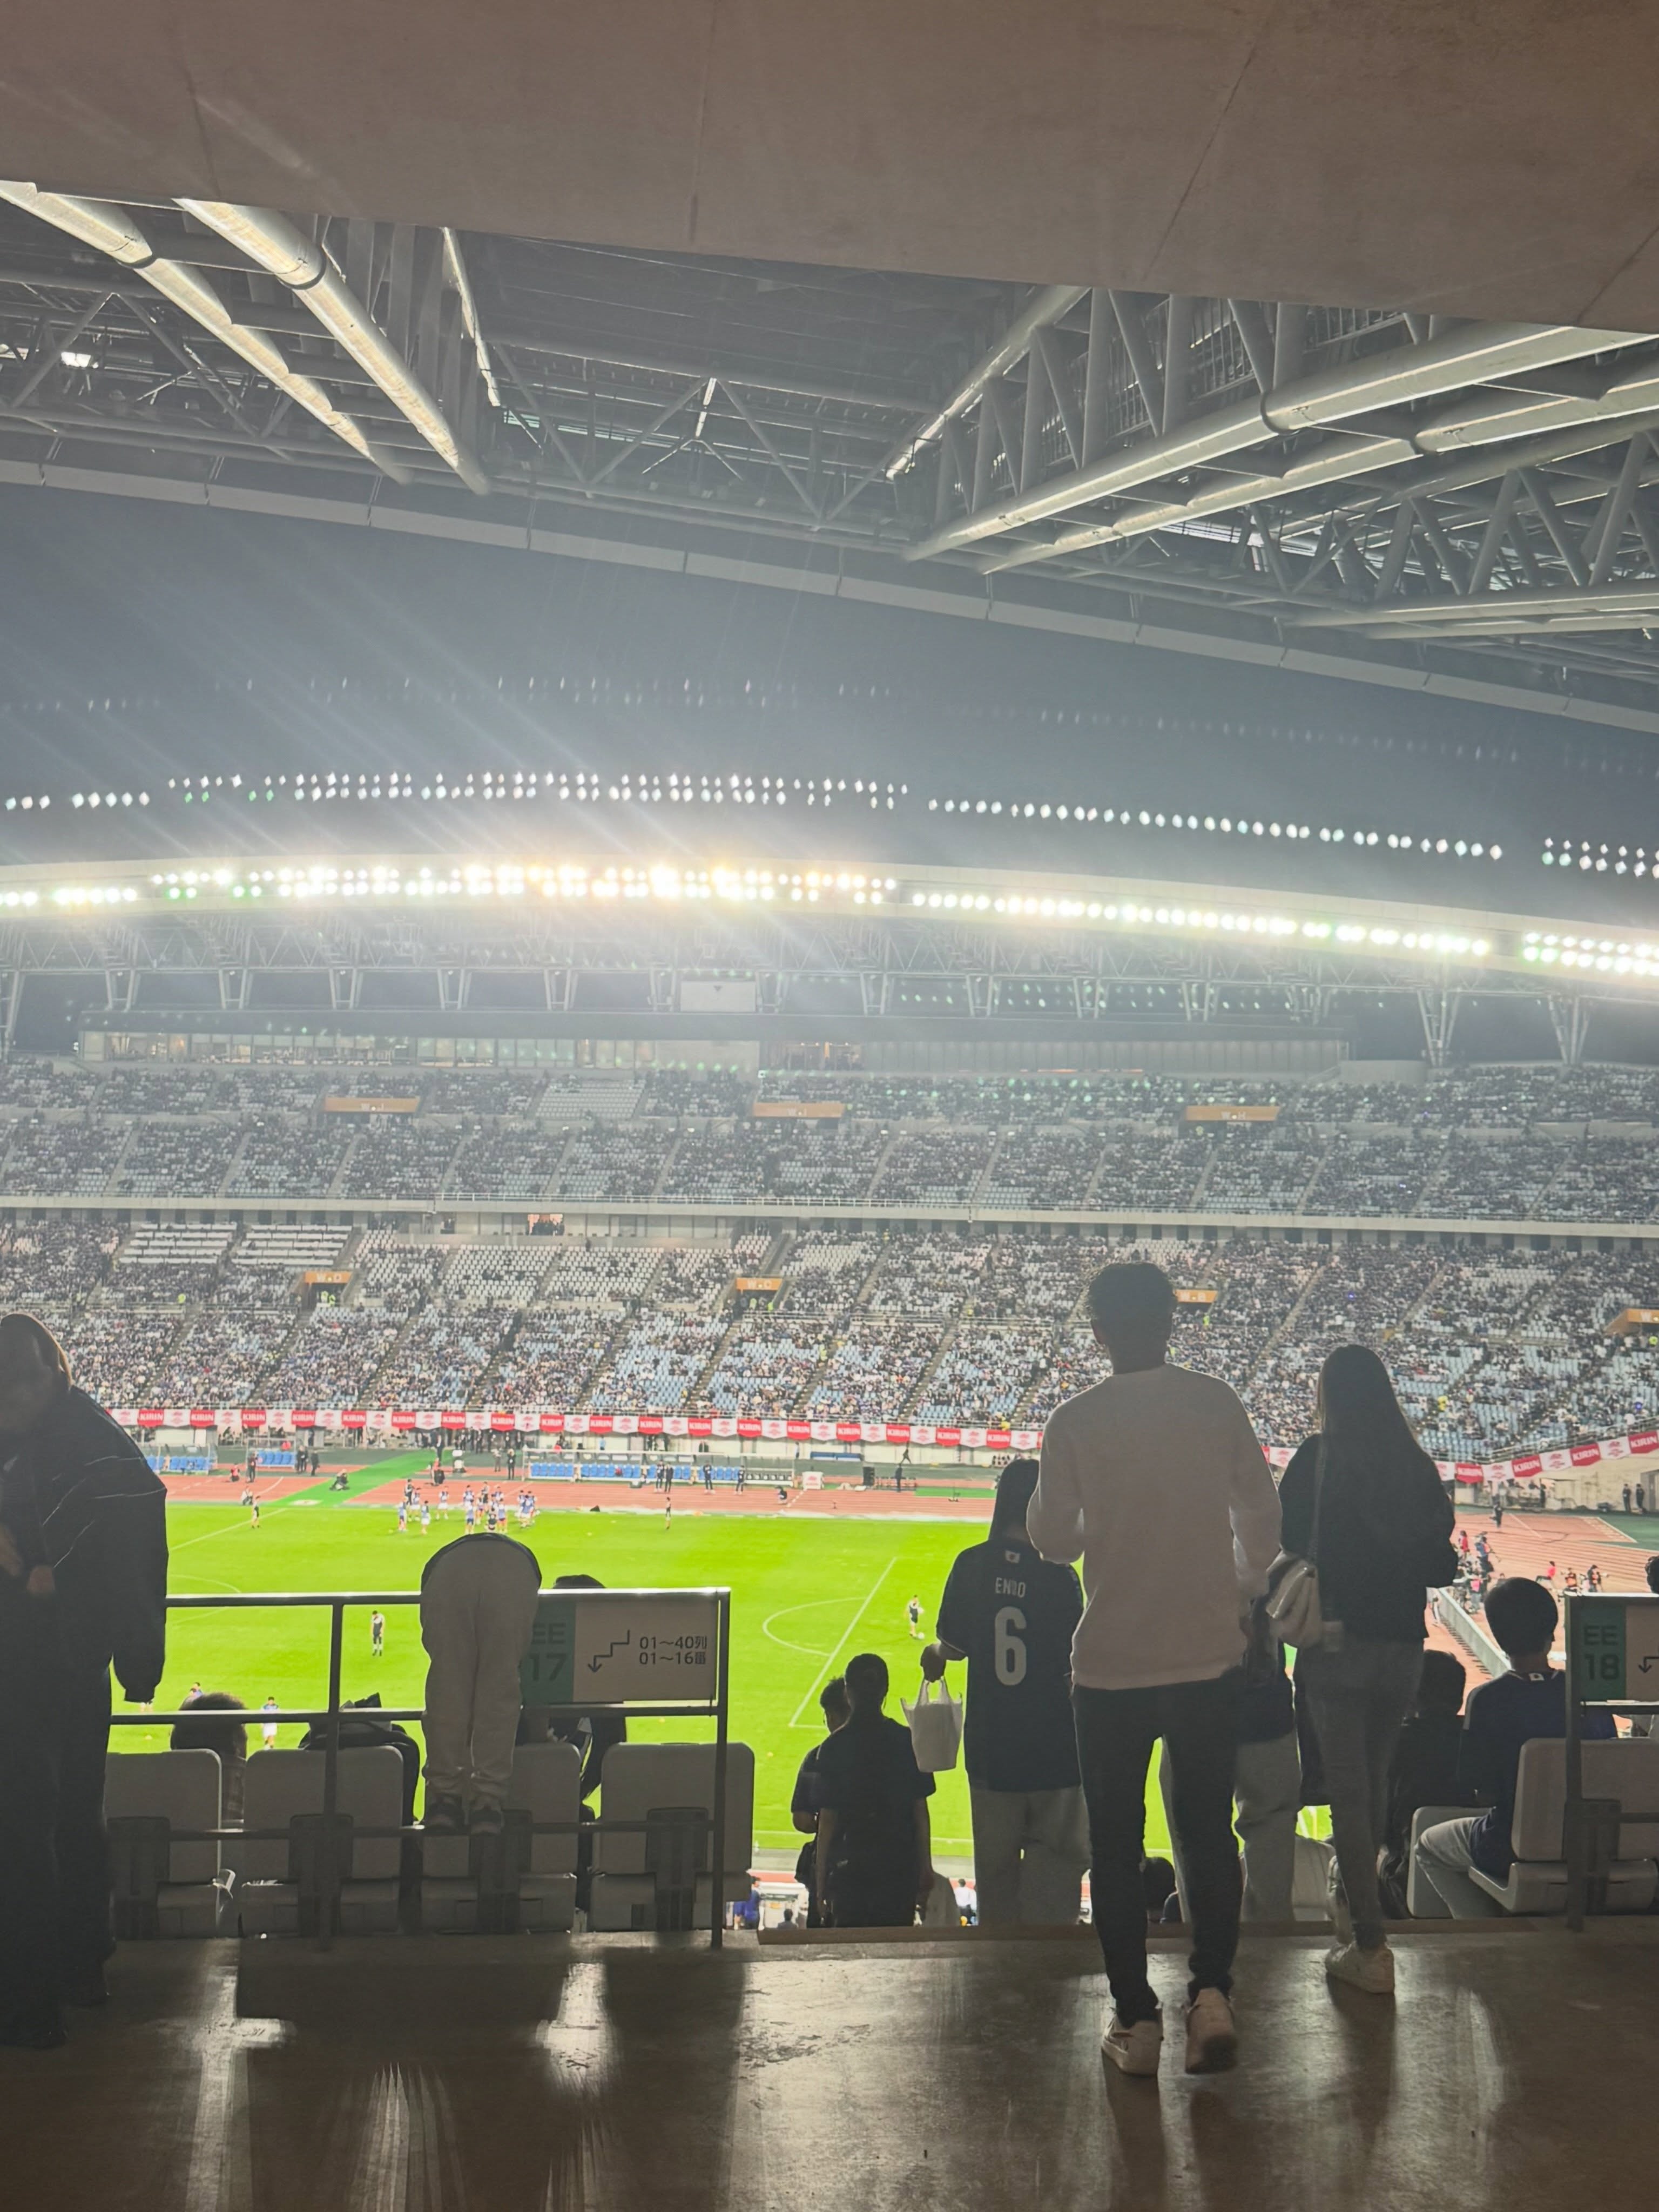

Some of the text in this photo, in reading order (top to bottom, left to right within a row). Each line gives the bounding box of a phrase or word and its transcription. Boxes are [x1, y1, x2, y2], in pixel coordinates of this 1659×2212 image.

[140, 1413, 164, 1421] KIRIN
[191, 1413, 214, 1421] KIRIN
[243, 1413, 266, 1421] KIRIN
[293, 1414, 315, 1422] KIRIN
[342, 1414, 365, 1422] KIRIN
[392, 1415, 415, 1423] KIRIN
[442, 1415, 465, 1424] KIRIN
[491, 1417, 514, 1425] KIRIN
[590, 1419, 612, 1427] KIRIN
[639, 1420, 662, 1428] KIRIN
[689, 1422, 711, 1430] KIRIN
[739, 1423, 761, 1432] KIRIN
[788, 1426, 810, 1434] KIRIN
[1631, 1436, 1658, 1447] KIRIN
[1573, 1448, 1600, 1460] KIRIN
[1514, 1460, 1541, 1472] KIRIN
[1458, 1467, 1482, 1476] KIRIN
[1584, 1624, 1618, 1645] EE
[995, 1606, 1026, 1685] 6
[529, 1653, 567, 1681] 17
[1584, 1654, 1619, 1681] 18
